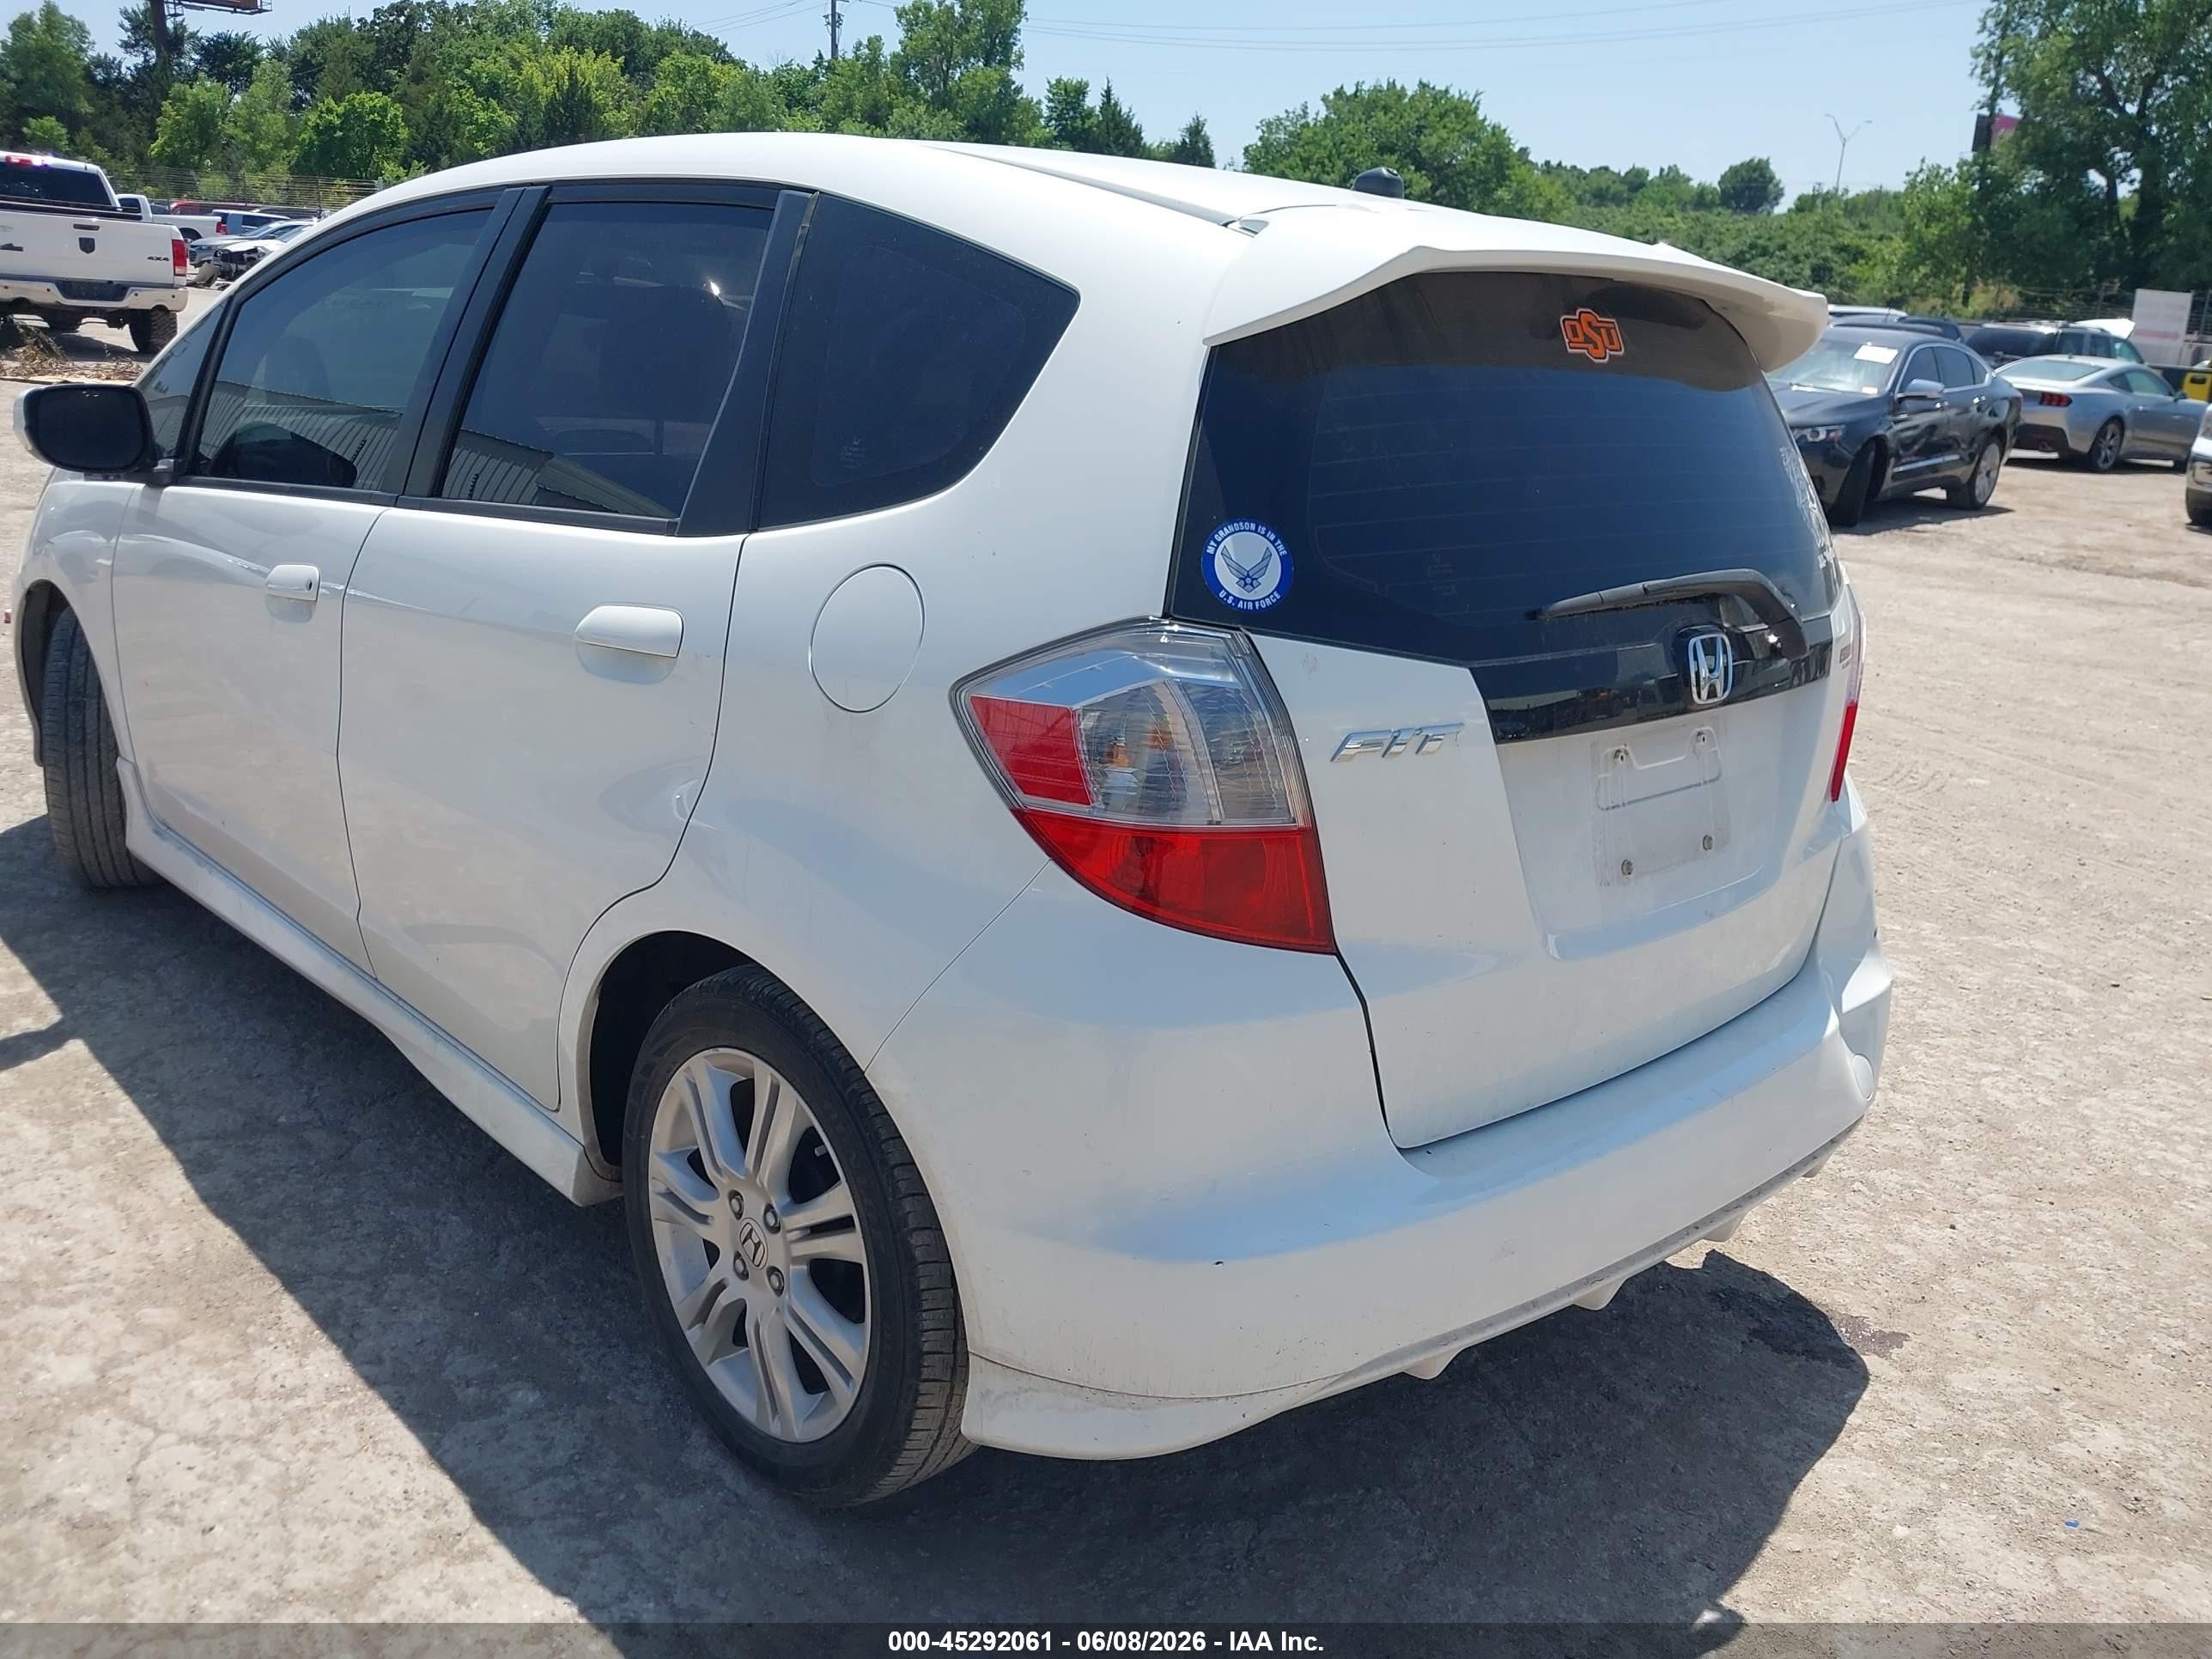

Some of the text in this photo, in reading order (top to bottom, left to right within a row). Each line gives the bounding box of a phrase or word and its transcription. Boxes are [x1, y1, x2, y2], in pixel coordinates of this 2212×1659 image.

[1563, 309, 1622, 361] OSU
[1206, 521, 1288, 557] MY GRANDSON IS IN THE
[1218, 589, 1281, 611] U.S. AIR FORCE
[1329, 722, 1465, 763] FIT
